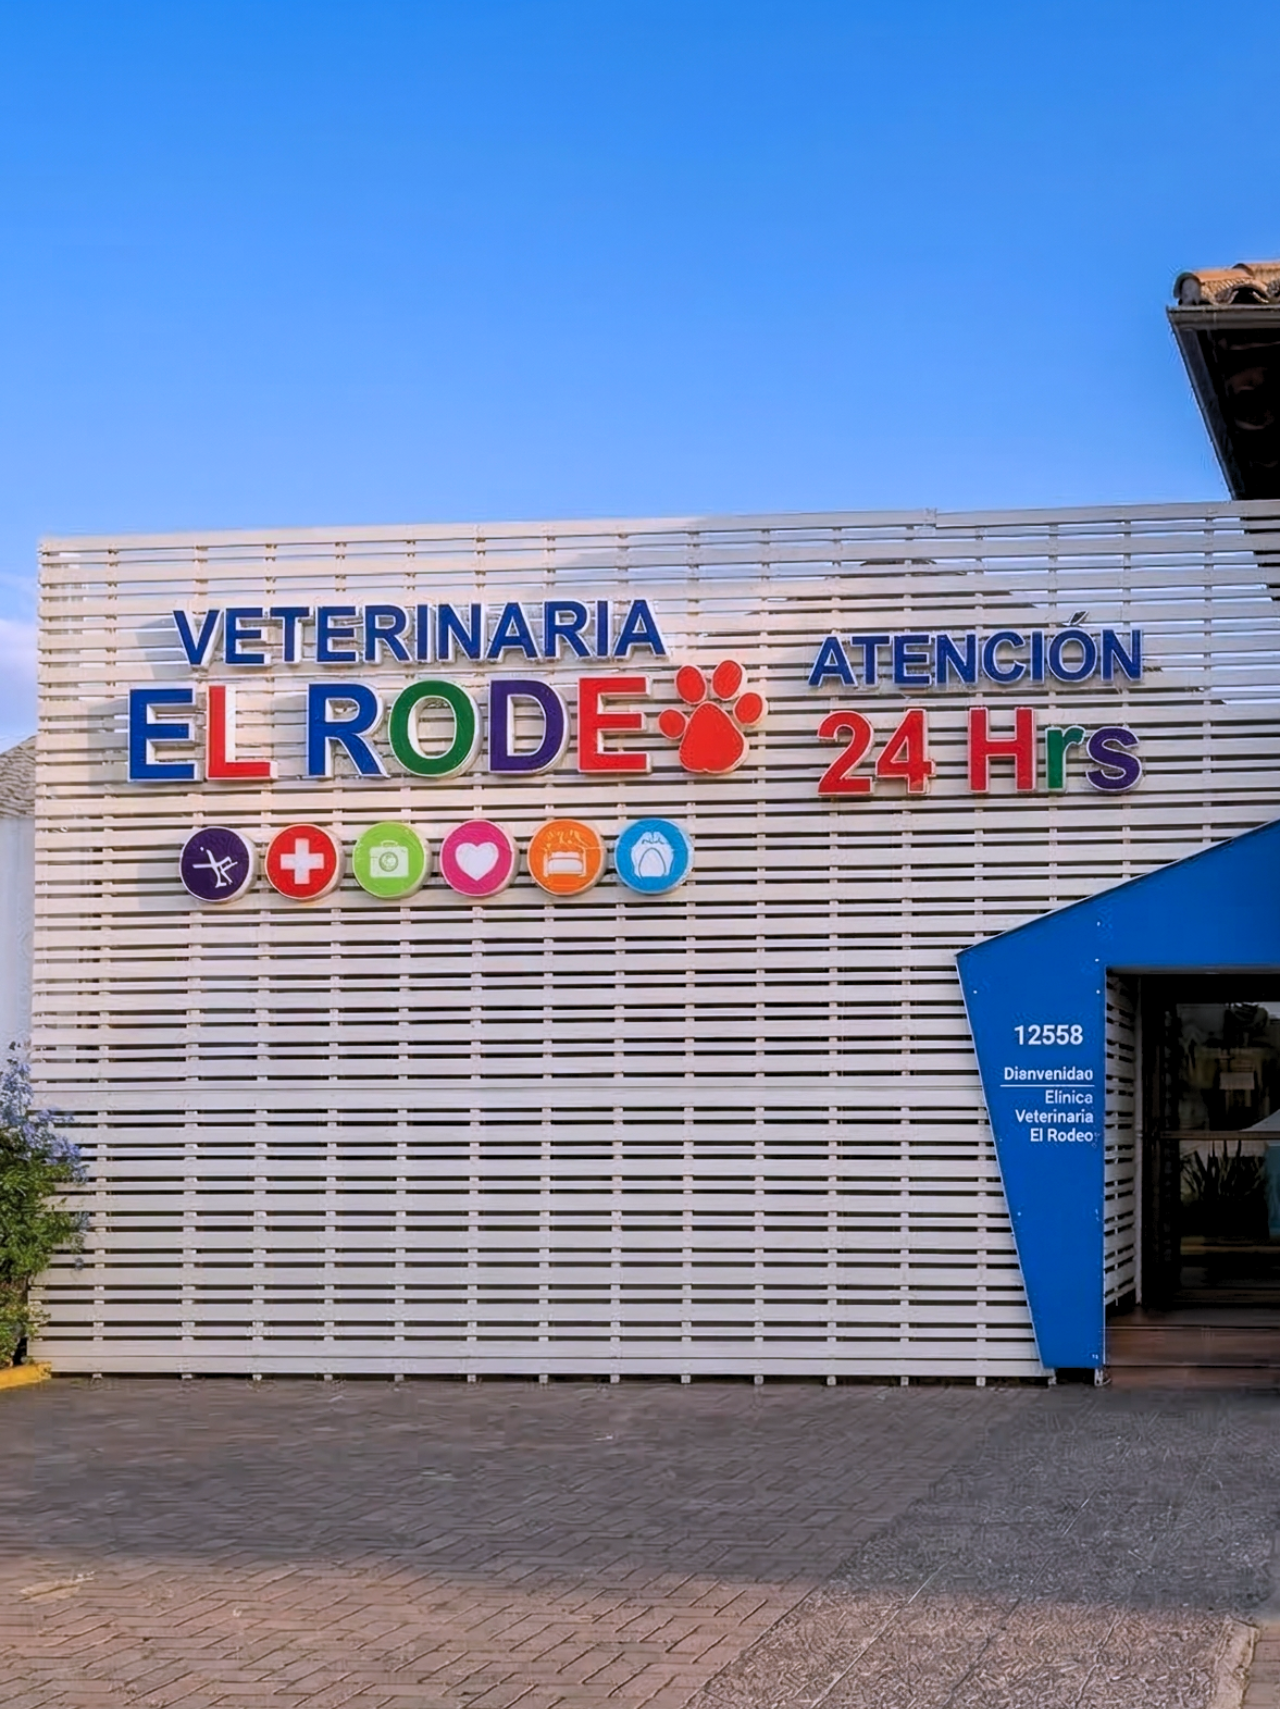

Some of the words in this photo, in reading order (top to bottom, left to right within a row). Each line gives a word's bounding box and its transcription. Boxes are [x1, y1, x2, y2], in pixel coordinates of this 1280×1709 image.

[173, 599, 668, 666] VETERINARIA
[808, 611, 1143, 687] ATENCIÓN
[127, 686, 279, 782] EL
[816, 707, 935, 796] 24
[966, 706, 1144, 795] Hrs
[1014, 1024, 1083, 1045] 12558
[1015, 1109, 1093, 1123] Veterinaria
[1030, 1128, 1043, 1142] El
[1047, 1128, 1093, 1142] Rodeo
